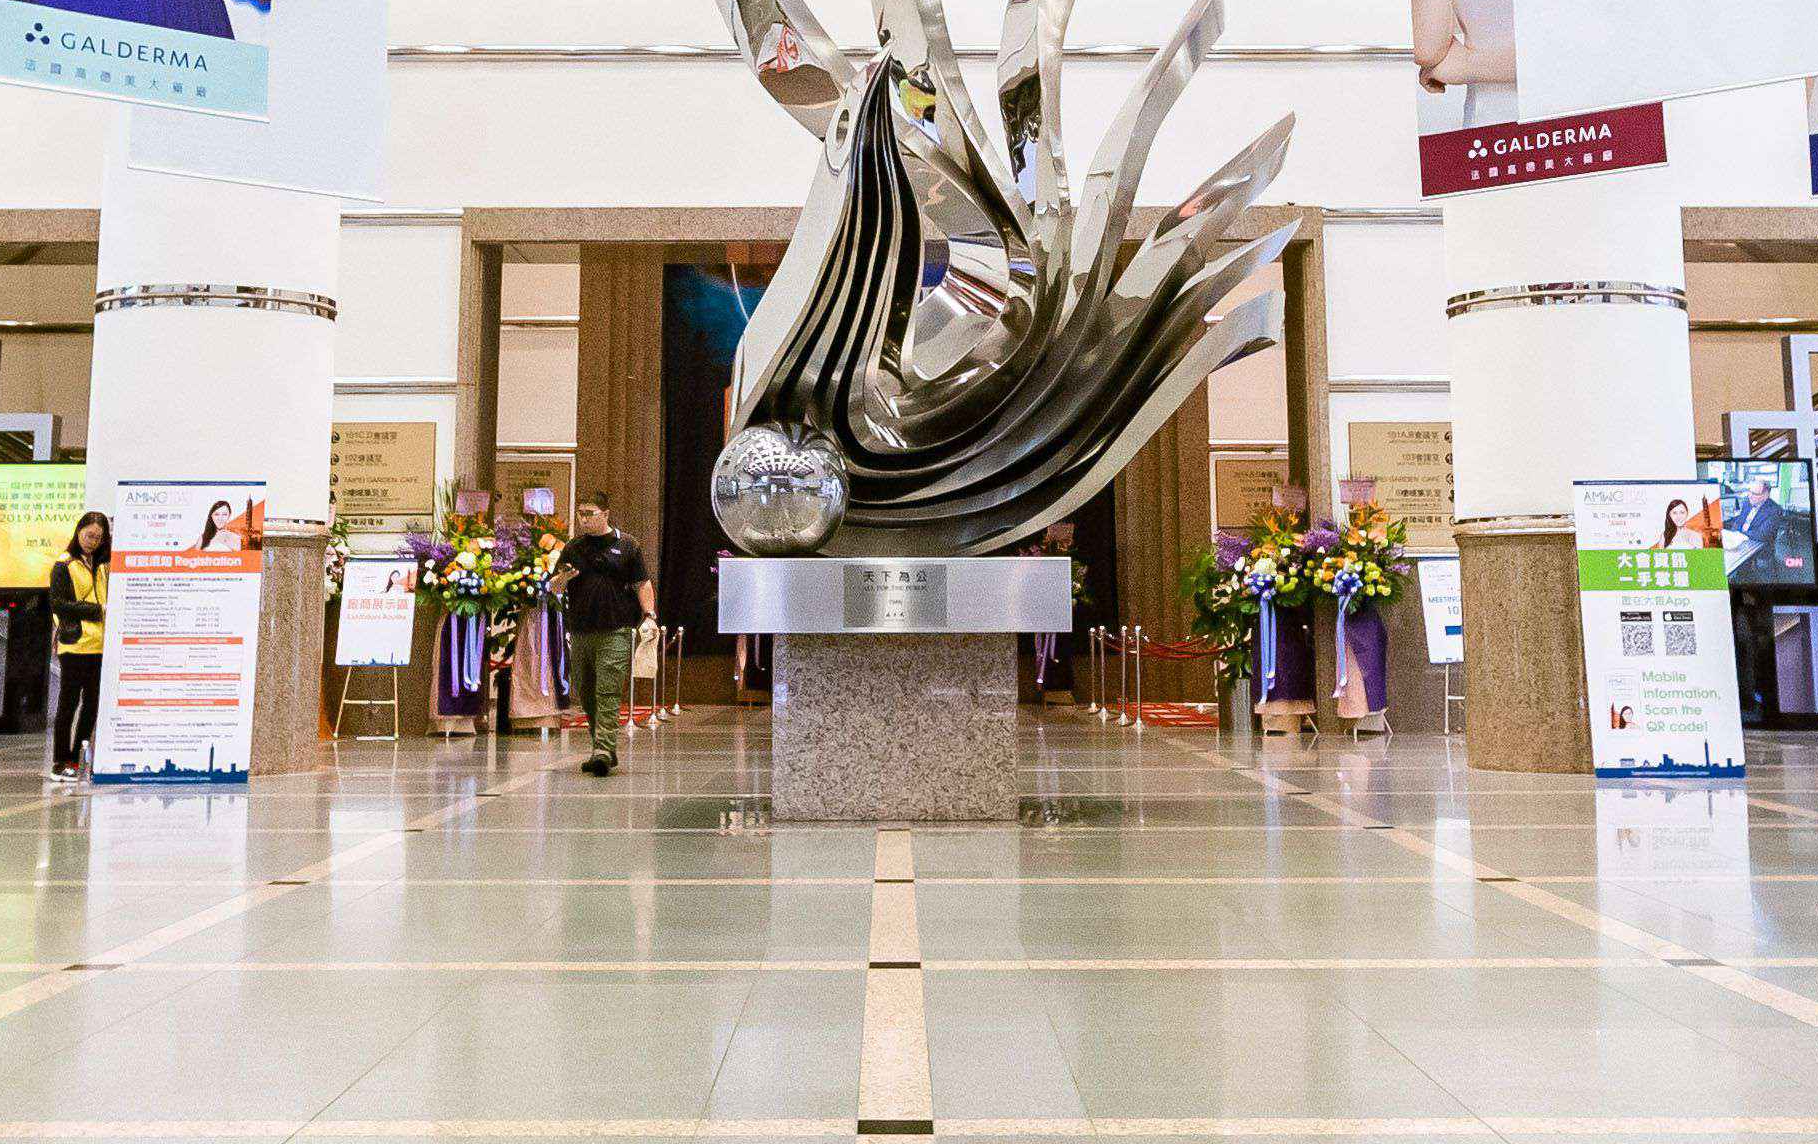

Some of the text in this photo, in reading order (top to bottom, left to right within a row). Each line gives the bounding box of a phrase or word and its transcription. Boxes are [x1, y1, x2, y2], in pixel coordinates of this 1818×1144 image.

[61, 31, 208, 72] GALDERMA
[1493, 123, 1613, 156] GALDERMA
[0, 513, 31, 523] 2019
[174, 555, 243, 569] Registration
[863, 570, 927, 583] 天下為公
[1642, 671, 1687, 683] Mobile
[1645, 704, 1702, 716] Scan the
[1646, 720, 1665, 733] QR
